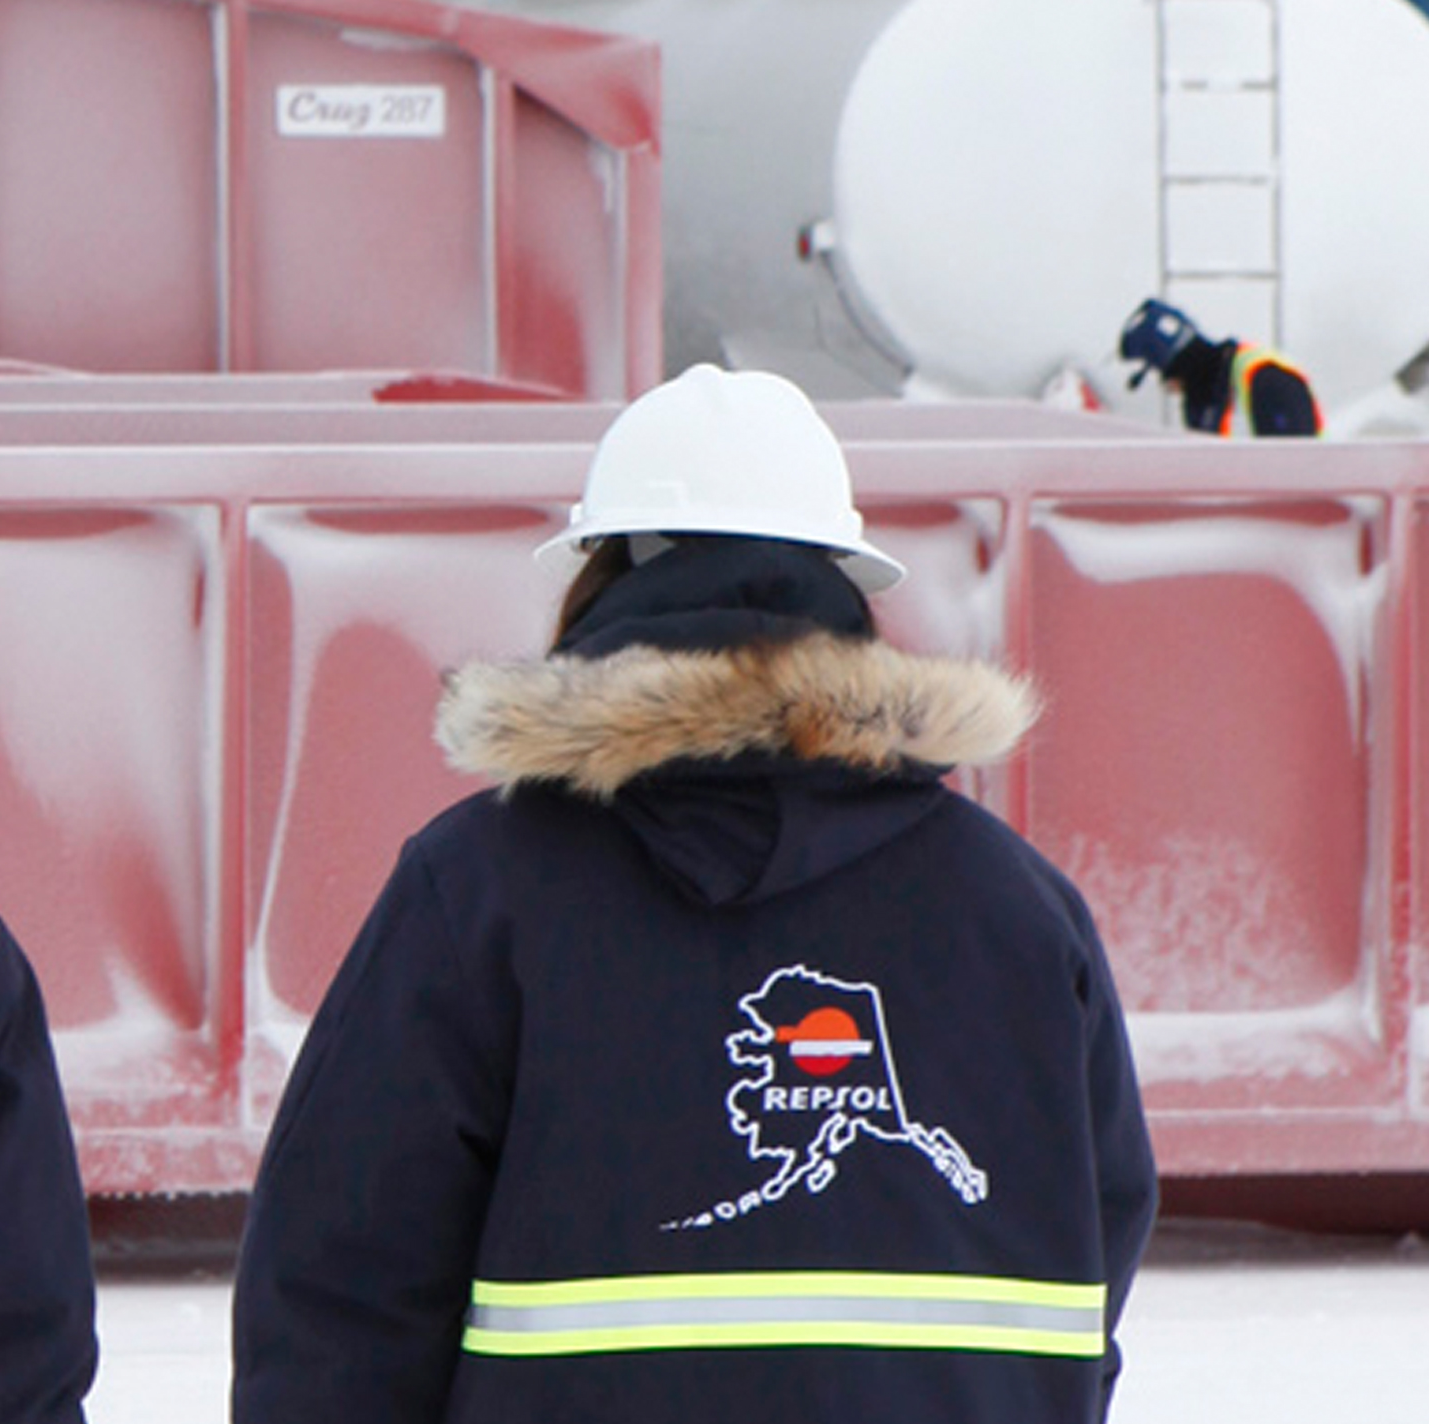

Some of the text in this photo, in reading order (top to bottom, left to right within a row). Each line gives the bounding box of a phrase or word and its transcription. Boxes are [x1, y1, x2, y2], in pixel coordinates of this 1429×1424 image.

[288, 91, 434, 130] Cruz 287
[763, 1086, 892, 1111] REPSOL
